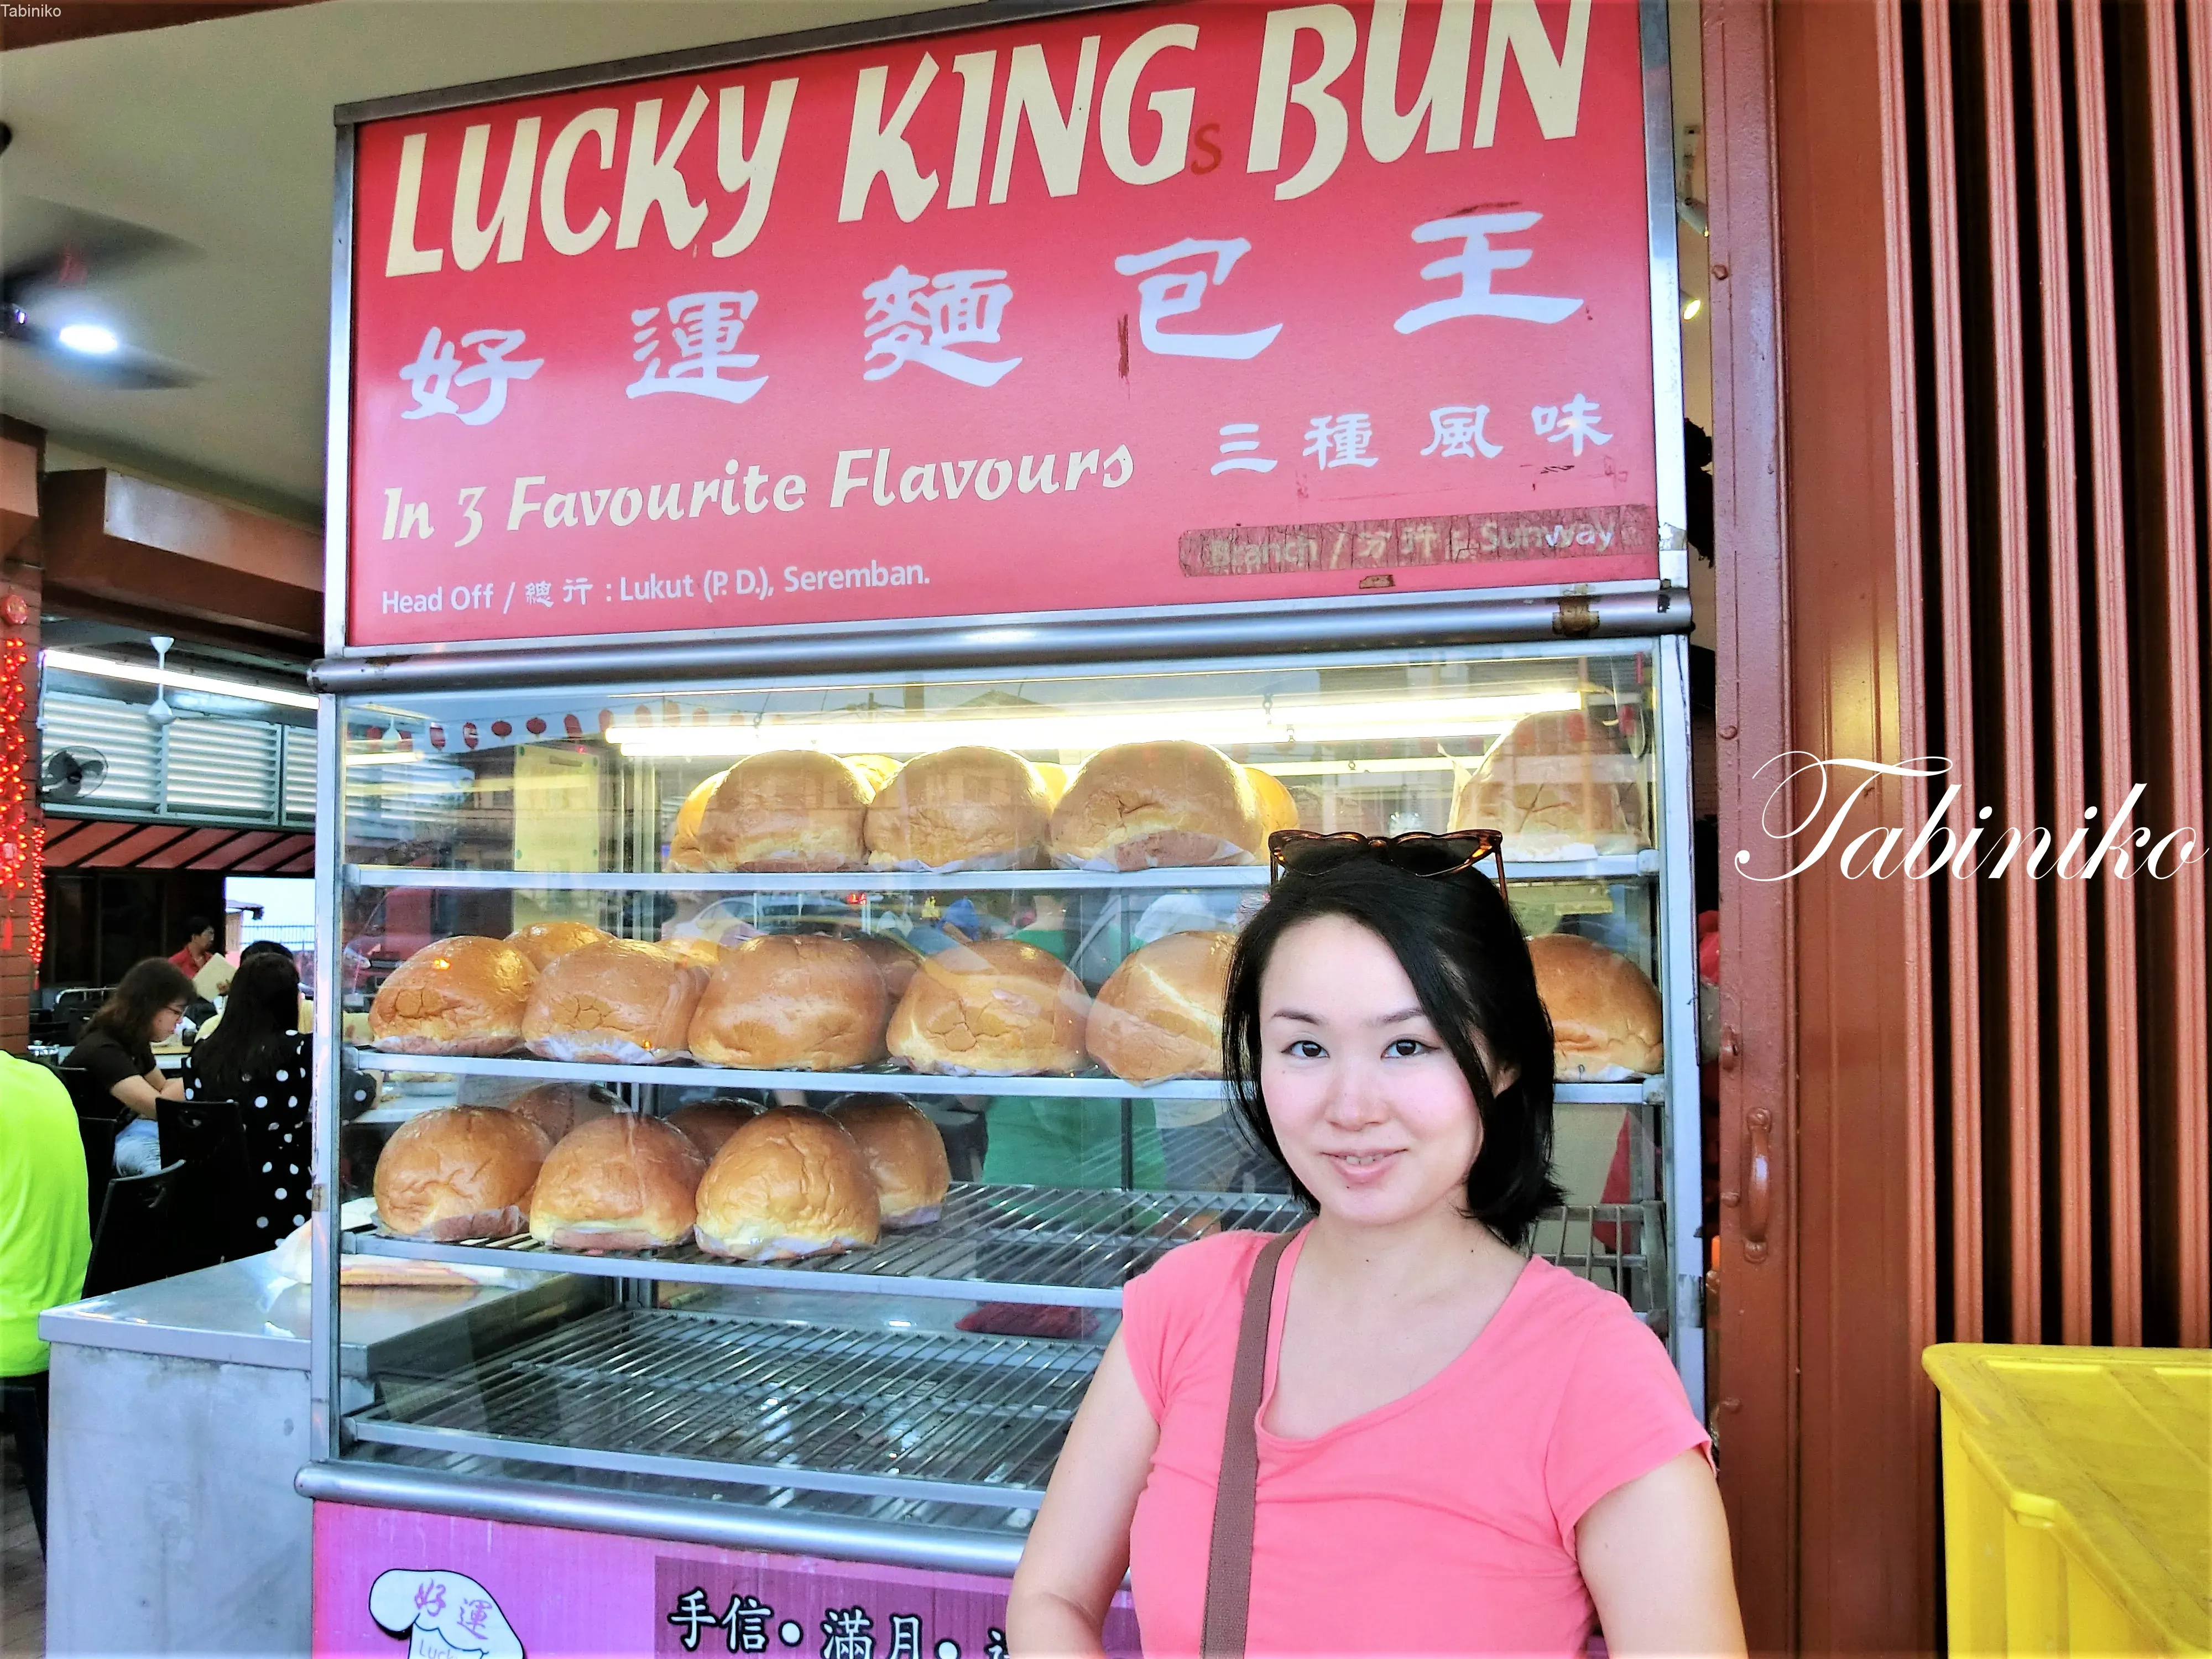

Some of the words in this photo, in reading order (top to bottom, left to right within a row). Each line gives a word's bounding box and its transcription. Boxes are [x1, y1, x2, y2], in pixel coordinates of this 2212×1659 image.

[384, 77, 800, 278] LUCKY
[1246, 0, 1591, 201] BUN
[1210, 393, 1614, 476] 三種風味
[382, 487, 435, 540] In
[453, 486, 487, 547] 3
[507, 459, 806, 531] Favourite
[830, 444, 1134, 509] Flavours
[382, 587, 443, 614] Head
[450, 583, 494, 611] Off
[503, 582, 516, 614] /
[620, 573, 695, 601] Lukut
[784, 560, 931, 593] Seremban.
